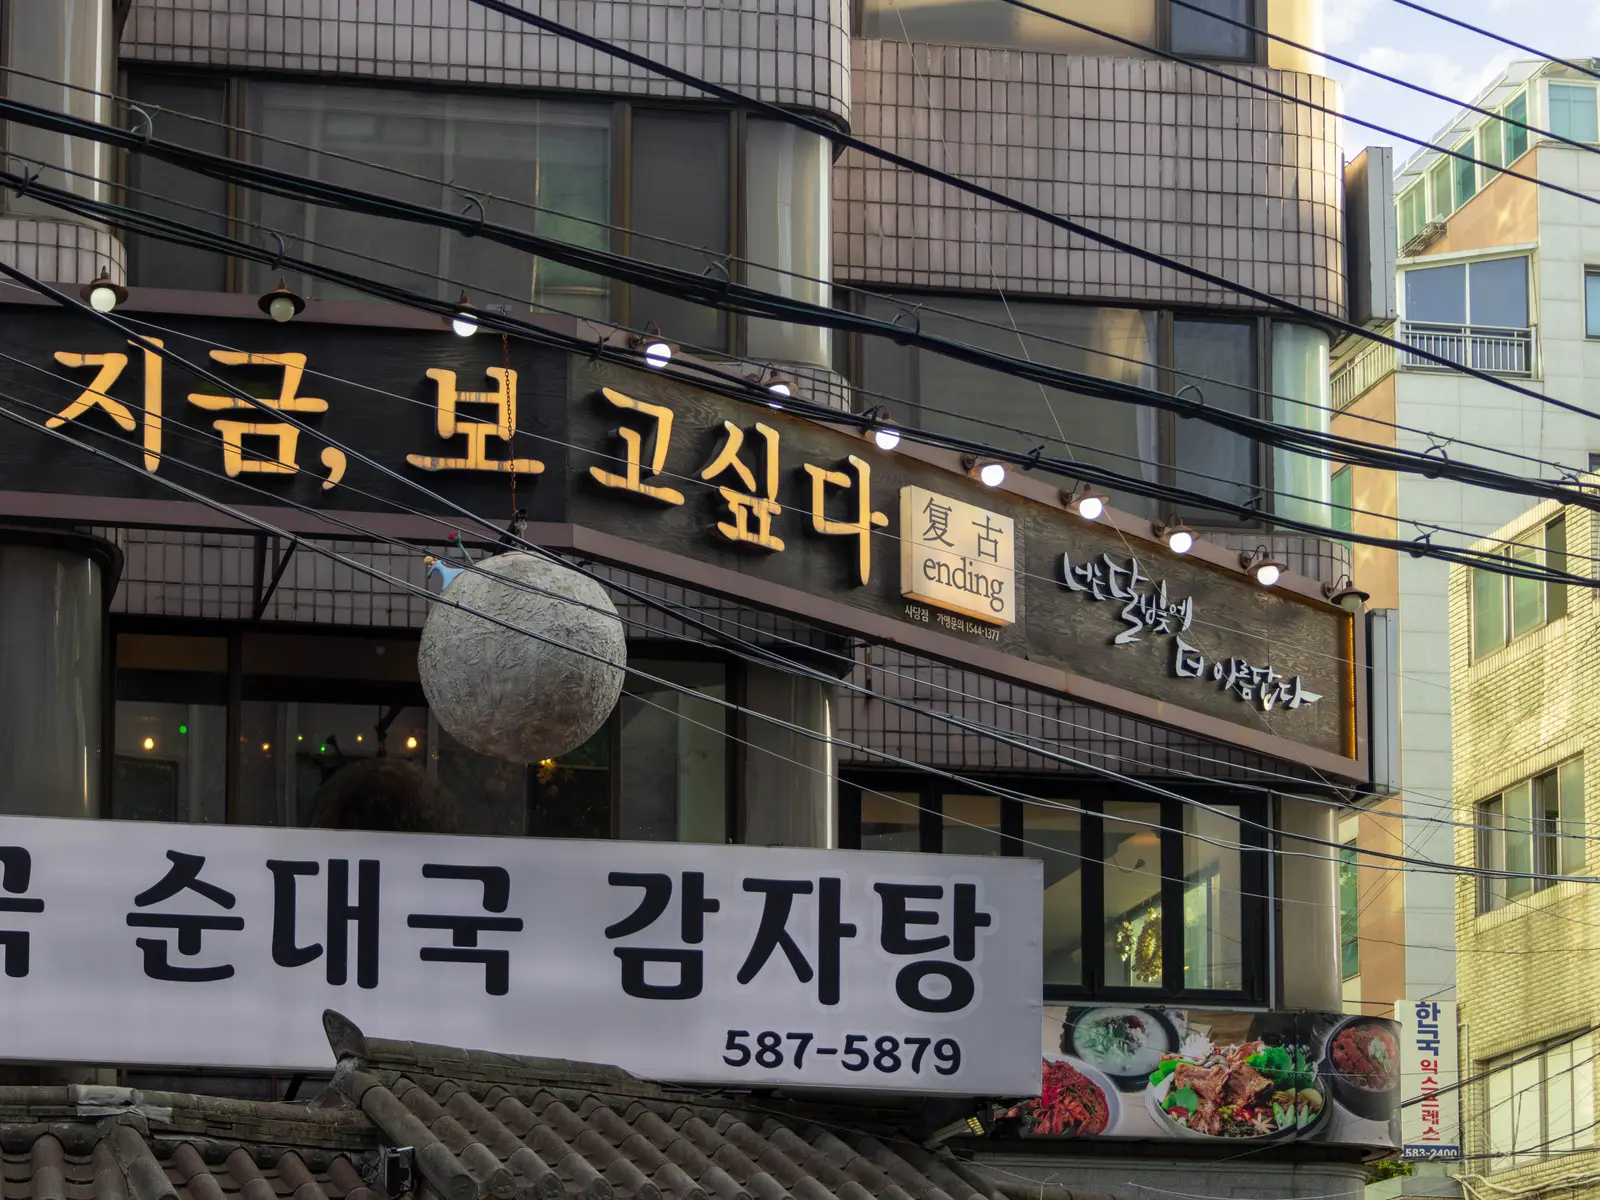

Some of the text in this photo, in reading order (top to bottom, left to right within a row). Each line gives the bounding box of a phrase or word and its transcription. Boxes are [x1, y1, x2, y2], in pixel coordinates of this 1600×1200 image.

[45, 336, 347, 490] 지금,
[922, 496, 1004, 563] 复古
[923, 556, 1005, 613] ending
[1103, 552, 1193, 645] 달빛에
[904, 604, 1001, 642] 사당점 가맹문의 1544-1377
[1176, 635, 1324, 712] 더 아름답다
[126, 849, 524, 996] 순대국
[604, 871, 992, 1013] 감자탕
[722, 1029, 962, 1076] 587-5879
[1415, 1001, 1441, 1056] 한국
